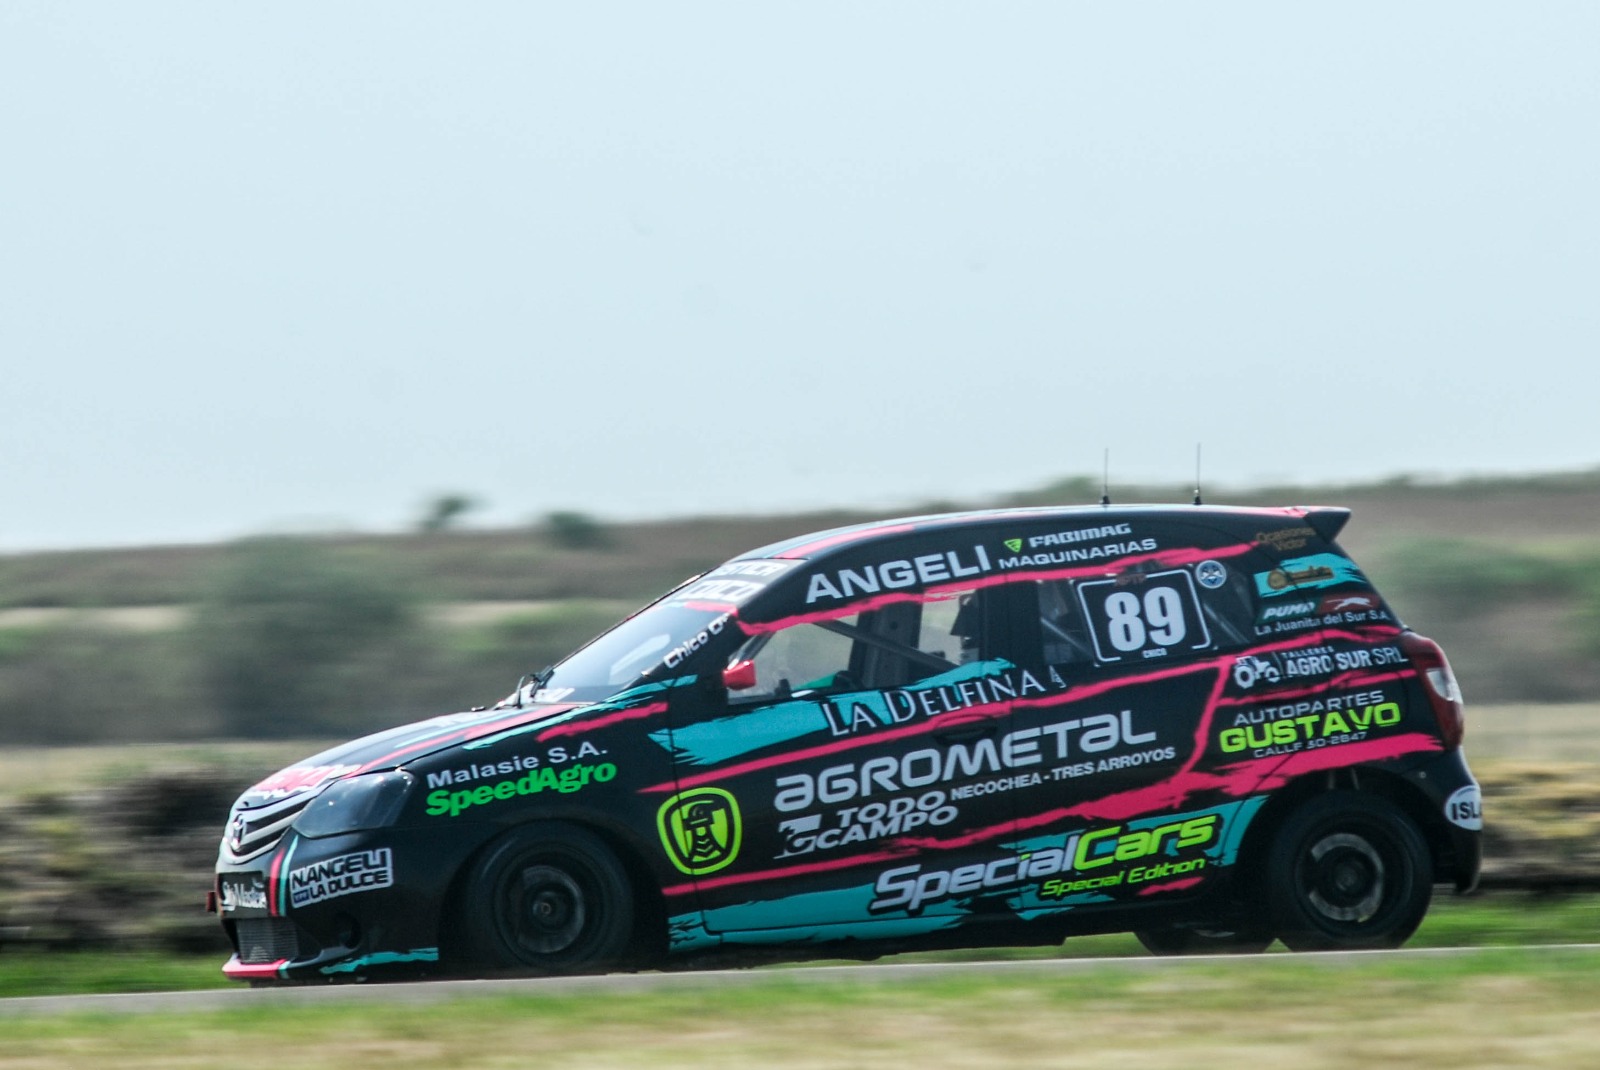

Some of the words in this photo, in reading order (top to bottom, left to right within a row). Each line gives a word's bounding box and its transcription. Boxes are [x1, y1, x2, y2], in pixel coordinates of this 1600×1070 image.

[998, 538, 1157, 569] MAQUINARIAS
[1028, 523, 1132, 548] FABIMAG
[805, 545, 992, 604] ANGELI
[1104, 586, 1186, 652] 89
[1323, 611, 1342, 625] del
[1345, 609, 1367, 622] Sur
[1286, 655, 1334, 676] AGRO
[1335, 650, 1373, 670] SUR
[1371, 646, 1409, 665] SRL
[822, 703, 877, 737] LA
[883, 670, 1046, 724] DELFINA
[1233, 690, 1385, 727] AUTOPARTES
[1219, 702, 1401, 753] GUSTAVO
[1254, 742, 1303, 758] CALLE
[426, 756, 540, 789] Malasie
[548, 741, 608, 764] S.A.
[773, 709, 1157, 812] AGROMETAL
[951, 771, 1042, 800] NECOCHEA
[1052, 761, 1095, 781] TRES
[1097, 746, 1176, 773] ARROYOS
[425, 762, 617, 817] SpeedAgro
[836, 790, 947, 828] TODO
[816, 805, 959, 850] CAMPO
[310, 880, 327, 899] LA
[328, 870, 389, 894] DULCE
[870, 815, 1217, 911] SpecialCars
[1041, 870, 1125, 896] Special
[1127, 857, 1206, 884] Edition
